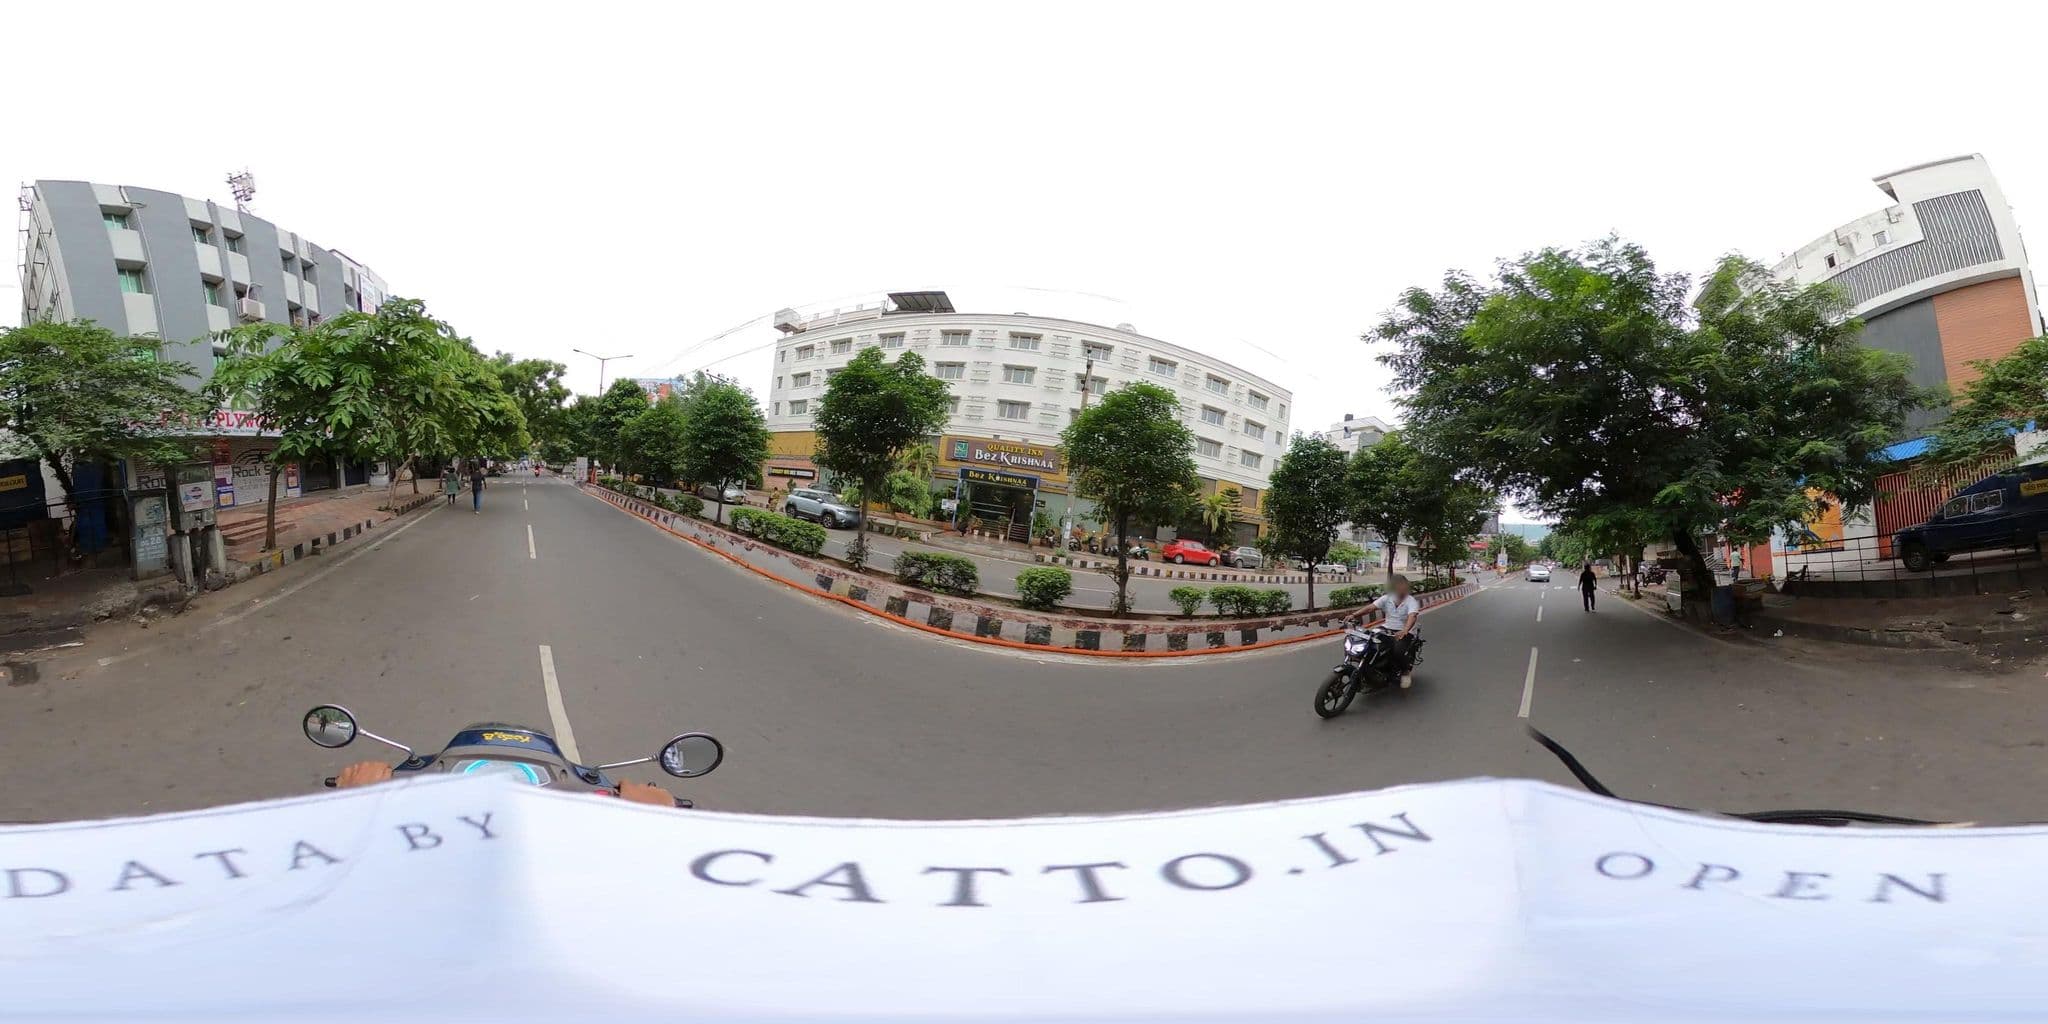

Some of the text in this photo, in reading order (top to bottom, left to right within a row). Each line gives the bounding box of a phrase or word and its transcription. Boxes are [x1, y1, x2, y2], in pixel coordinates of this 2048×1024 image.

[215, 409, 281, 428] PLYWO
[975, 449, 997, 461] Bez
[987, 443, 1045, 457] QUALITY INN
[232, 465, 261, 478] Rock
[3, 810, 501, 899] DATA BY
[688, 810, 1434, 908] CATTO.IN
[1594, 850, 1949, 904] OPEN
